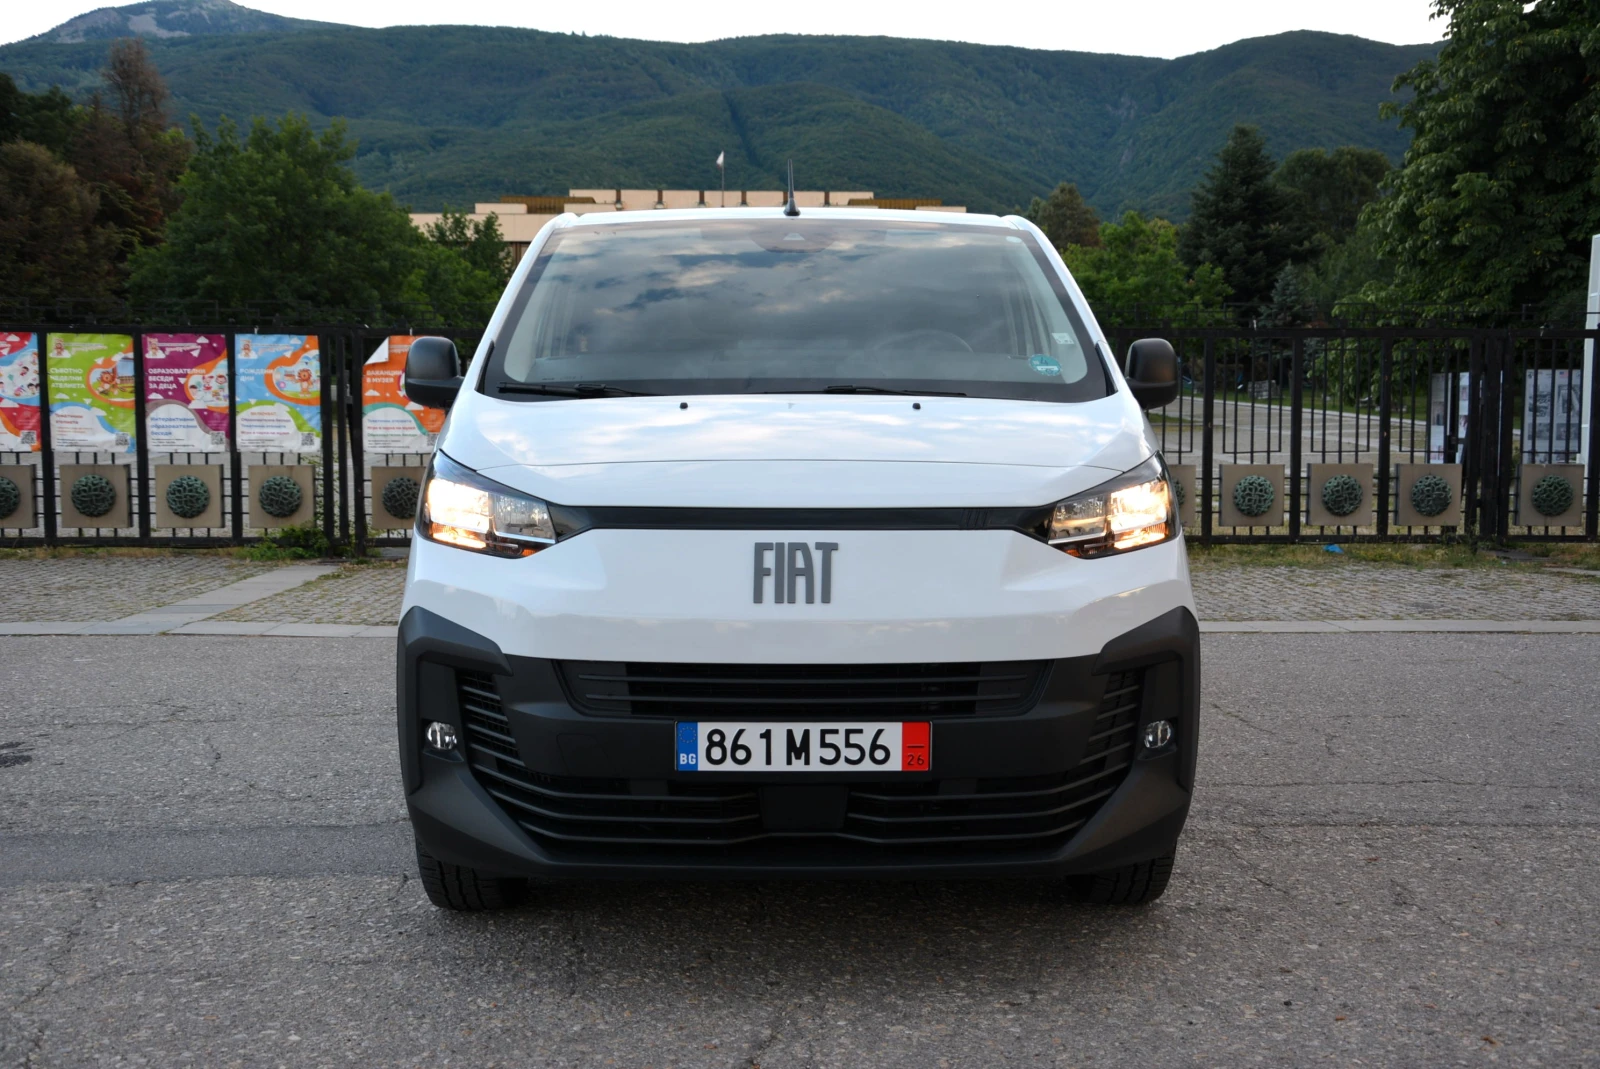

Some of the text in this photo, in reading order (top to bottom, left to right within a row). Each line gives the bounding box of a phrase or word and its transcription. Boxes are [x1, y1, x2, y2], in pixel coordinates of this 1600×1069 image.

[753, 542, 839, 604] FIAT
[679, 753, 697, 765] BG
[906, 753, 925, 766] 26
